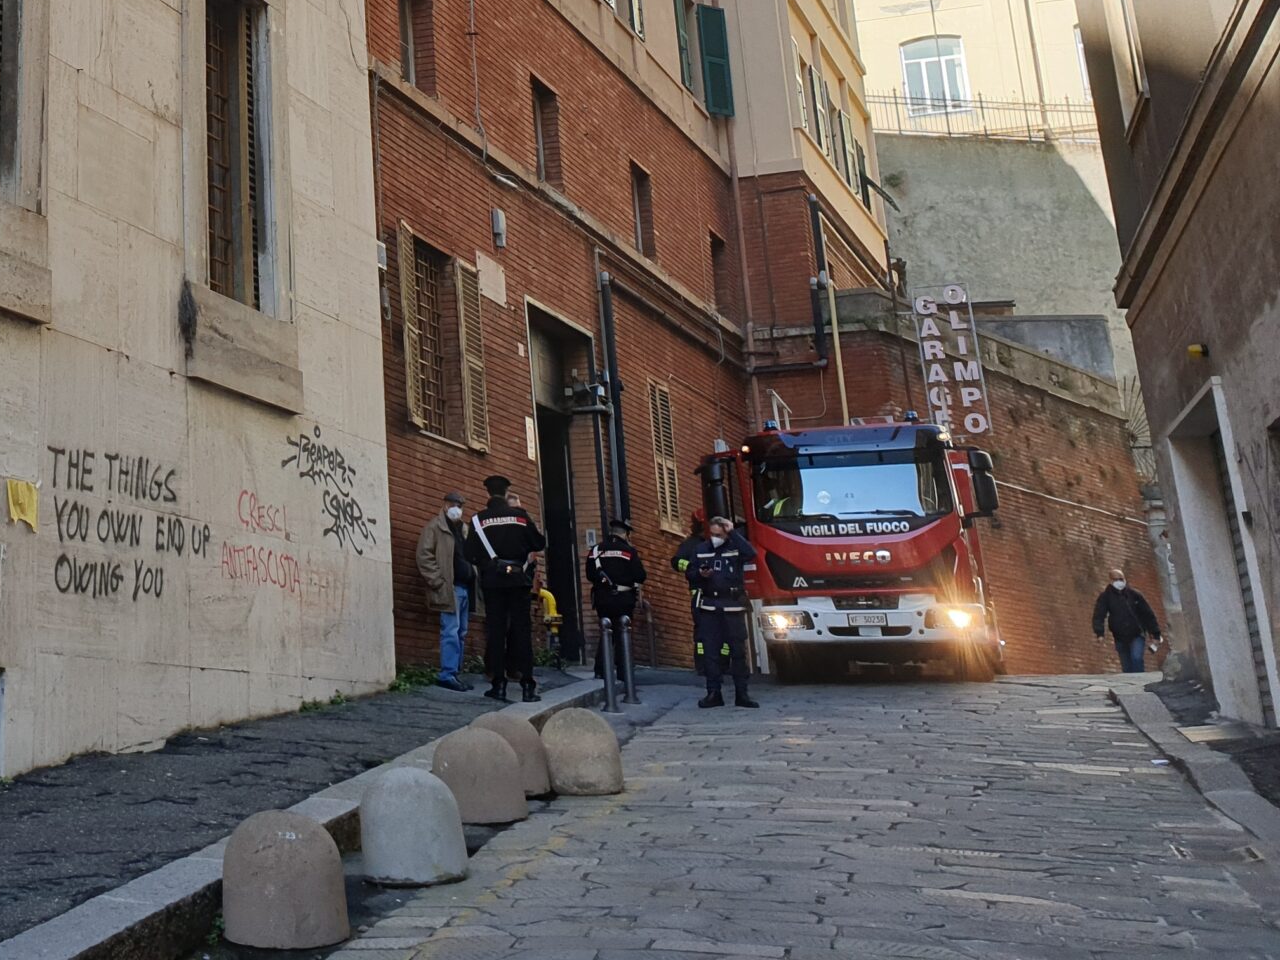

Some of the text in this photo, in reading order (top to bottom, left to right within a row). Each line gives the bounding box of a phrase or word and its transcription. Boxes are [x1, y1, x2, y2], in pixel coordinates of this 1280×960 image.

[943, 285, 987, 434] OLIMPO
[47, 445, 177, 502] THE THINGS
[53, 495, 211, 559] YOU OWN END UP
[800, 521, 910, 537] VIGILI DEL FUOCO
[54, 553, 163, 602] OWING YOU
[825, 550, 891, 565] IVECO
